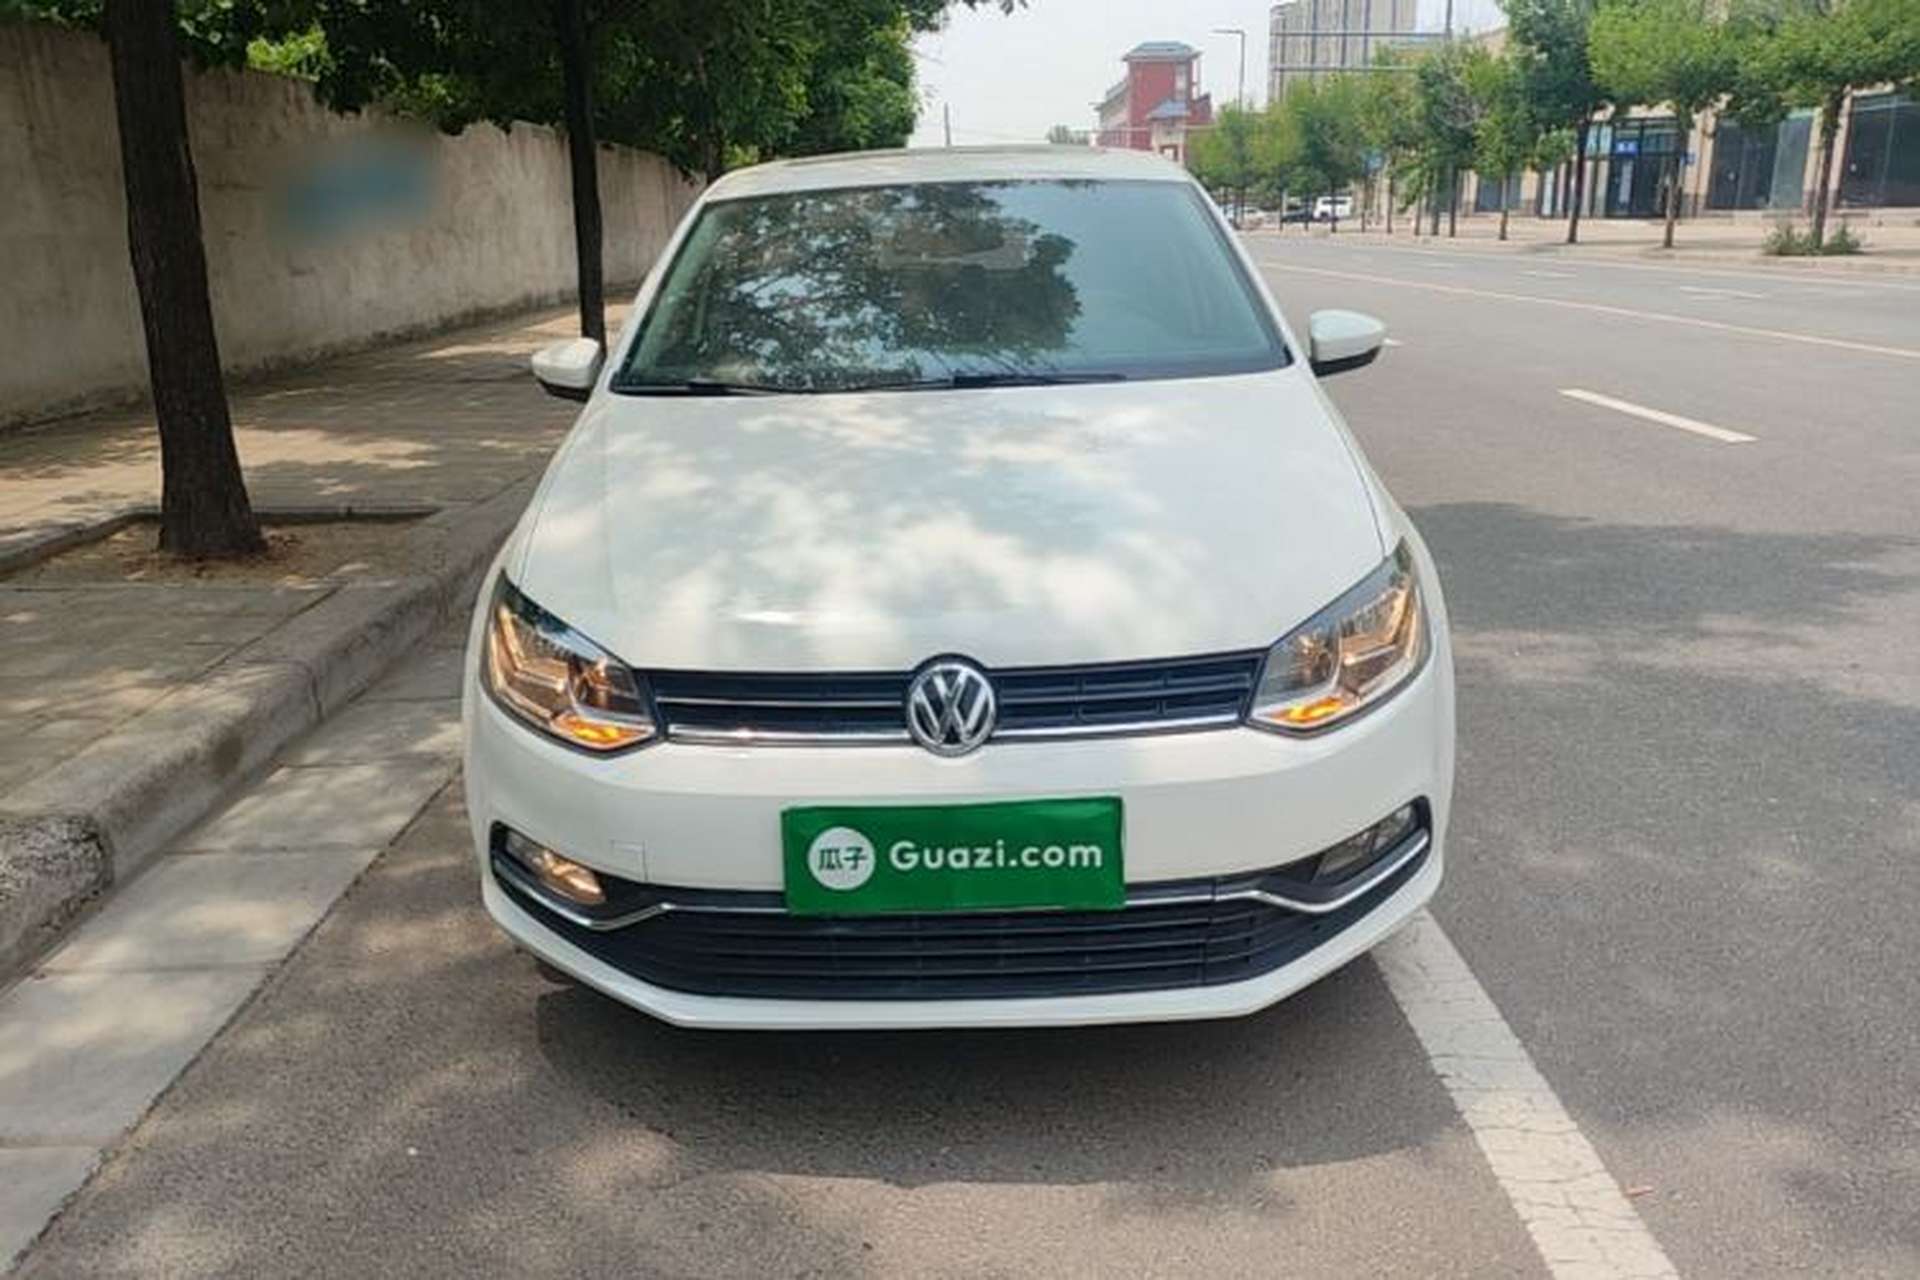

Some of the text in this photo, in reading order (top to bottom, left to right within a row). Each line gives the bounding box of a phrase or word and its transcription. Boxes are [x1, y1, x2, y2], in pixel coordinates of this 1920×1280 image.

[910, 664, 994, 752] VW
[818, 847, 867, 871] 瓜子
[889, 839, 1102, 871] Guazi.com
